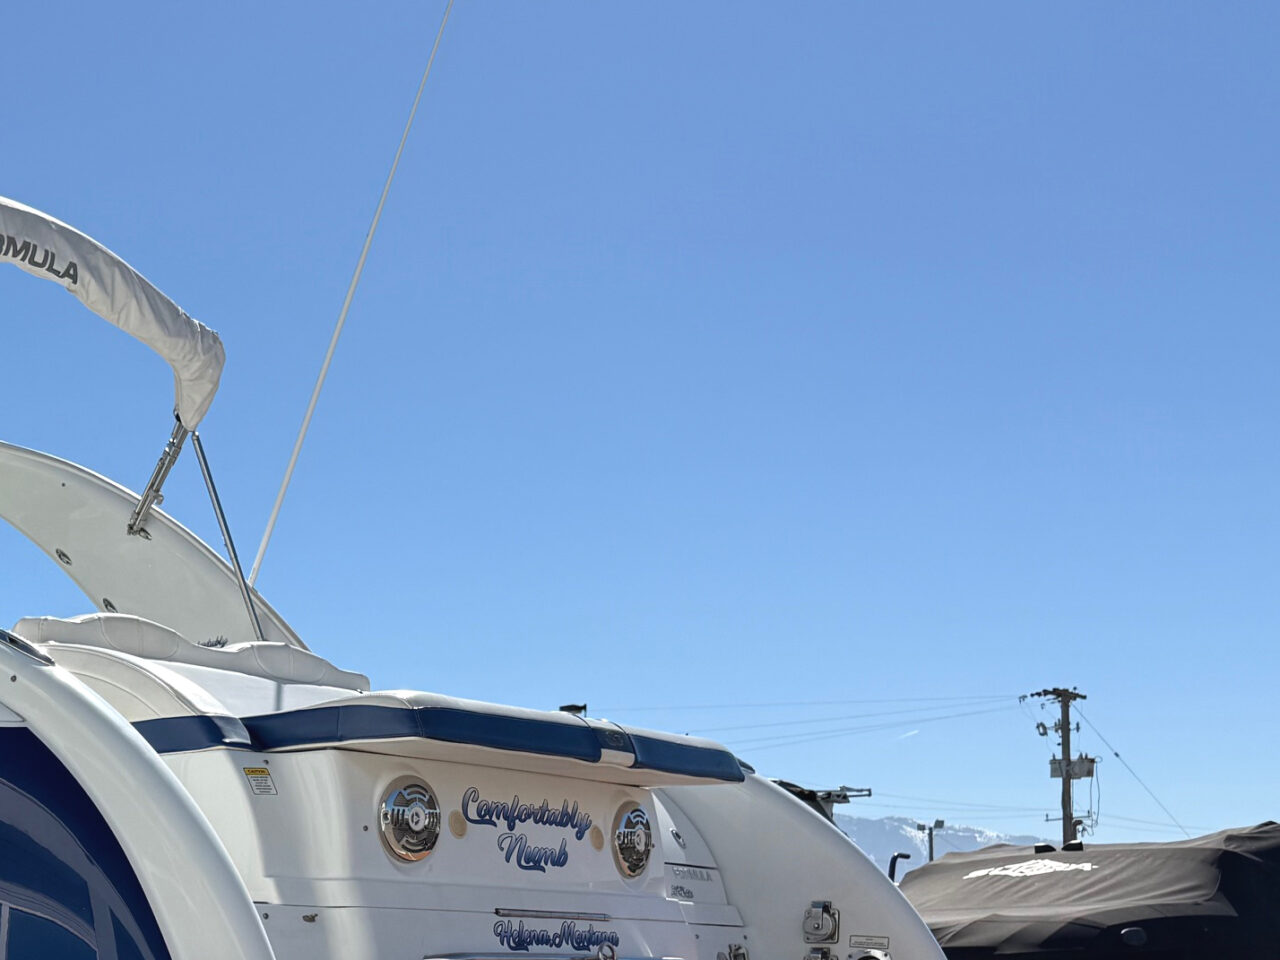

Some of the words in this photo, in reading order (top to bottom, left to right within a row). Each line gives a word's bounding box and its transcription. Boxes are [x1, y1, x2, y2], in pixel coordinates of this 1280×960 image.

[461, 786, 593, 841] Comfortably
[497, 832, 568, 873] Numb
[551, 920, 620, 952] Montana
